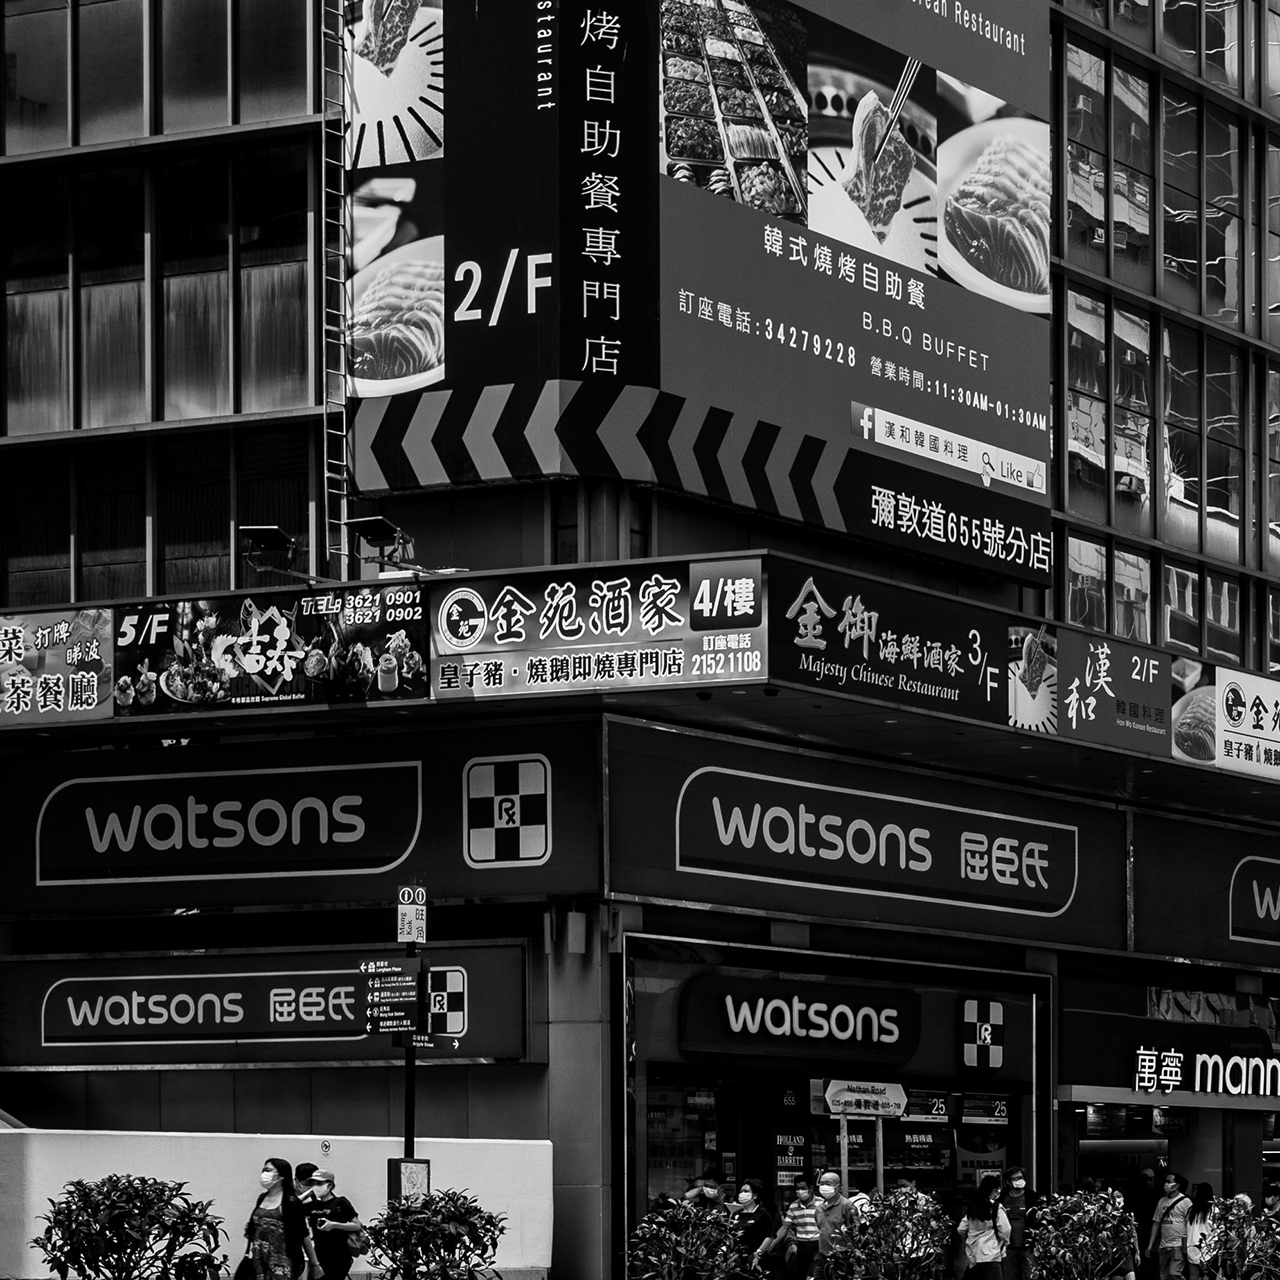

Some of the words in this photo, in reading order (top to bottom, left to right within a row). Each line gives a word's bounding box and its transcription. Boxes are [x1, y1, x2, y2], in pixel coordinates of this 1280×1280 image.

[954, 1, 1026, 56] Restaurant
[454, 248, 553, 327] 2/F
[764, 224, 926, 310] 韓式燒烤自助餐
[862, 312, 912, 346] B.B.Q
[922, 332, 989, 372] BUFFET
[884, 420, 969, 463] 漢和韓國料理
[1000, 460, 1023, 484] Like
[871, 485, 1050, 573] 彌敦道655號分店
[301, 596, 342, 615] TEL:
[346, 593, 382, 610] 3621
[386, 590, 422, 606] 0901
[345, 610, 382, 626] 3621
[386, 607, 423, 623] 0902
[489, 574, 685, 645] 金苑酒家
[693, 577, 755, 618] 4/樓
[35, 620, 71, 650] 打牌
[117, 613, 170, 647] 5/F
[702, 633, 751, 651] 訂座電話
[66, 638, 101, 667] 睇波
[692, 654, 725, 676] 2152
[727, 651, 762, 673] 1108
[967, 628, 999, 703] 3/F
[1131, 655, 1160, 684] 2/F
[799, 651, 848, 683] Majesty
[851, 661, 895, 692] Chinese
[897, 671, 961, 701] Restaurant
[1223, 739, 1254, 762] 皇子豬
[86, 793, 366, 854] watsons
[712, 795, 933, 873] watsons
[960, 829, 1049, 891] 屈臣氏
[399, 912, 408, 936] Mong
[67, 986, 245, 1028] watsons
[269, 985, 356, 1023] 屈臣氏
[725, 995, 900, 1044] watsons
[1135, 1045, 1184, 1094] 萬寧
[847, 1085, 871, 1095] Nathan
[870, 1086, 887, 1096] Road
[777, 1134, 805, 1145] HOLLAND
[776, 1155, 804, 1167] BARRETT
